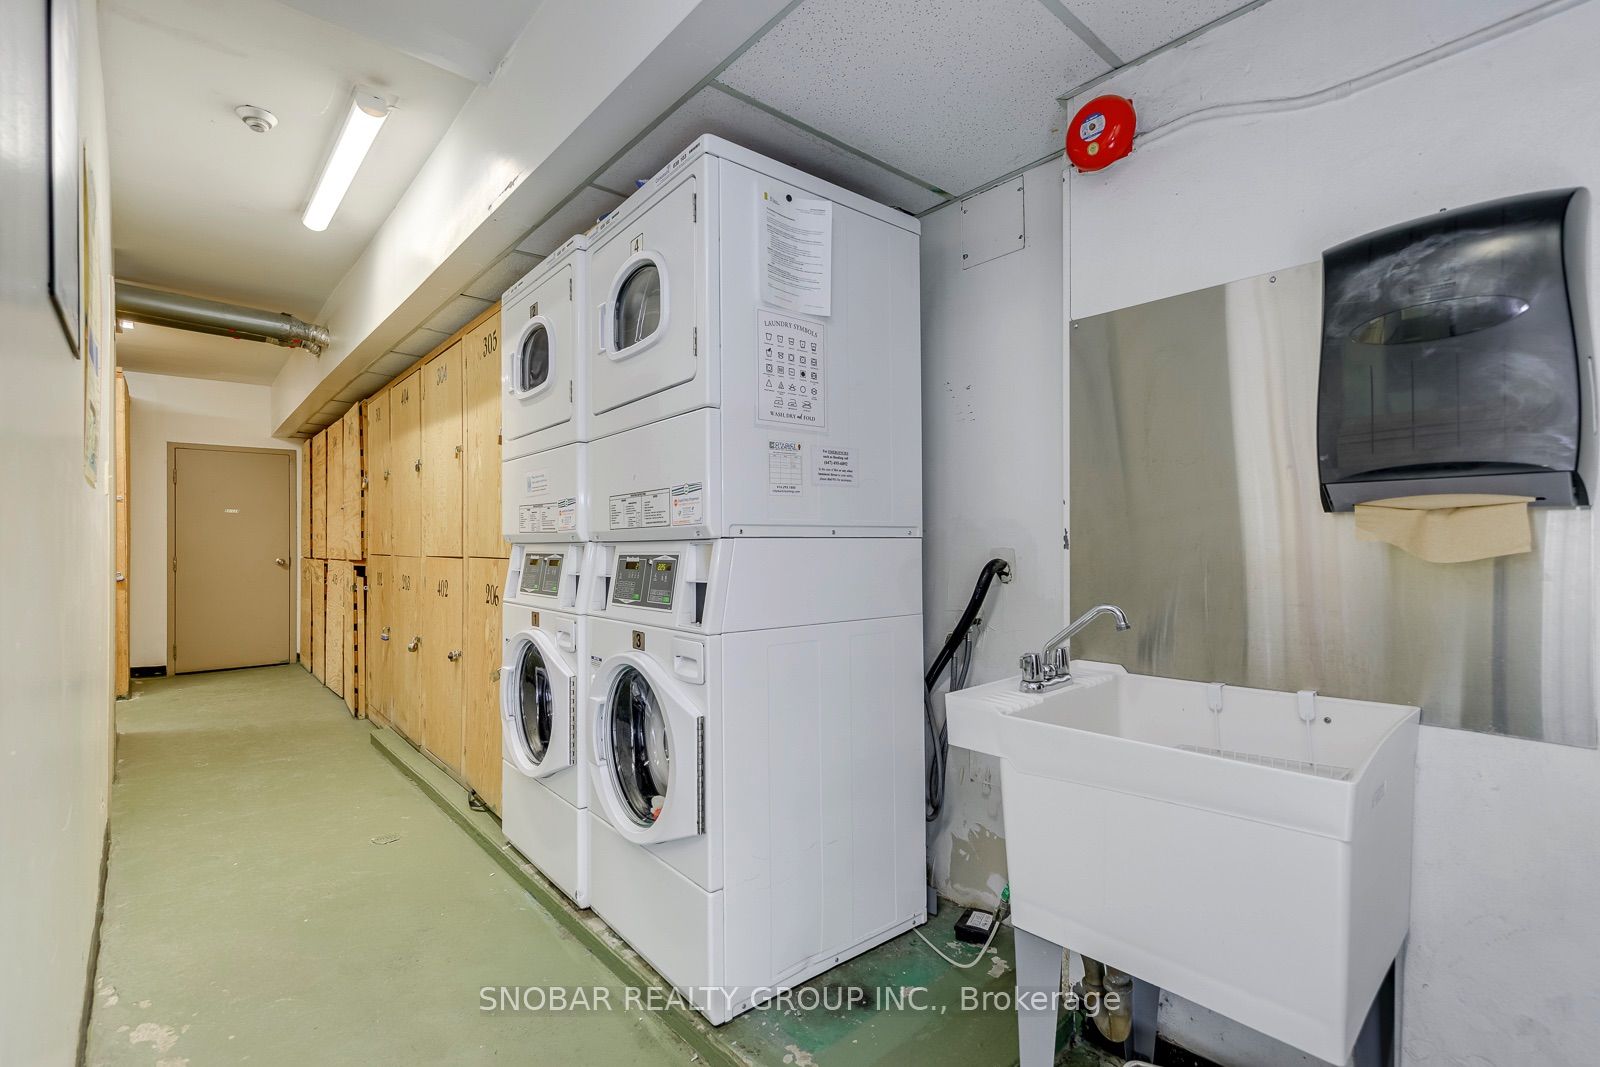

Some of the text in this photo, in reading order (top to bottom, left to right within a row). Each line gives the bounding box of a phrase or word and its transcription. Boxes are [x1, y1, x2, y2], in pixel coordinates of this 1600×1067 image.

[764, 320, 818, 338] LAUNDRY SYMBOLS
[482, 329, 498, 358] 305
[437, 579, 449, 598] 402
[485, 583, 500, 607] 206
